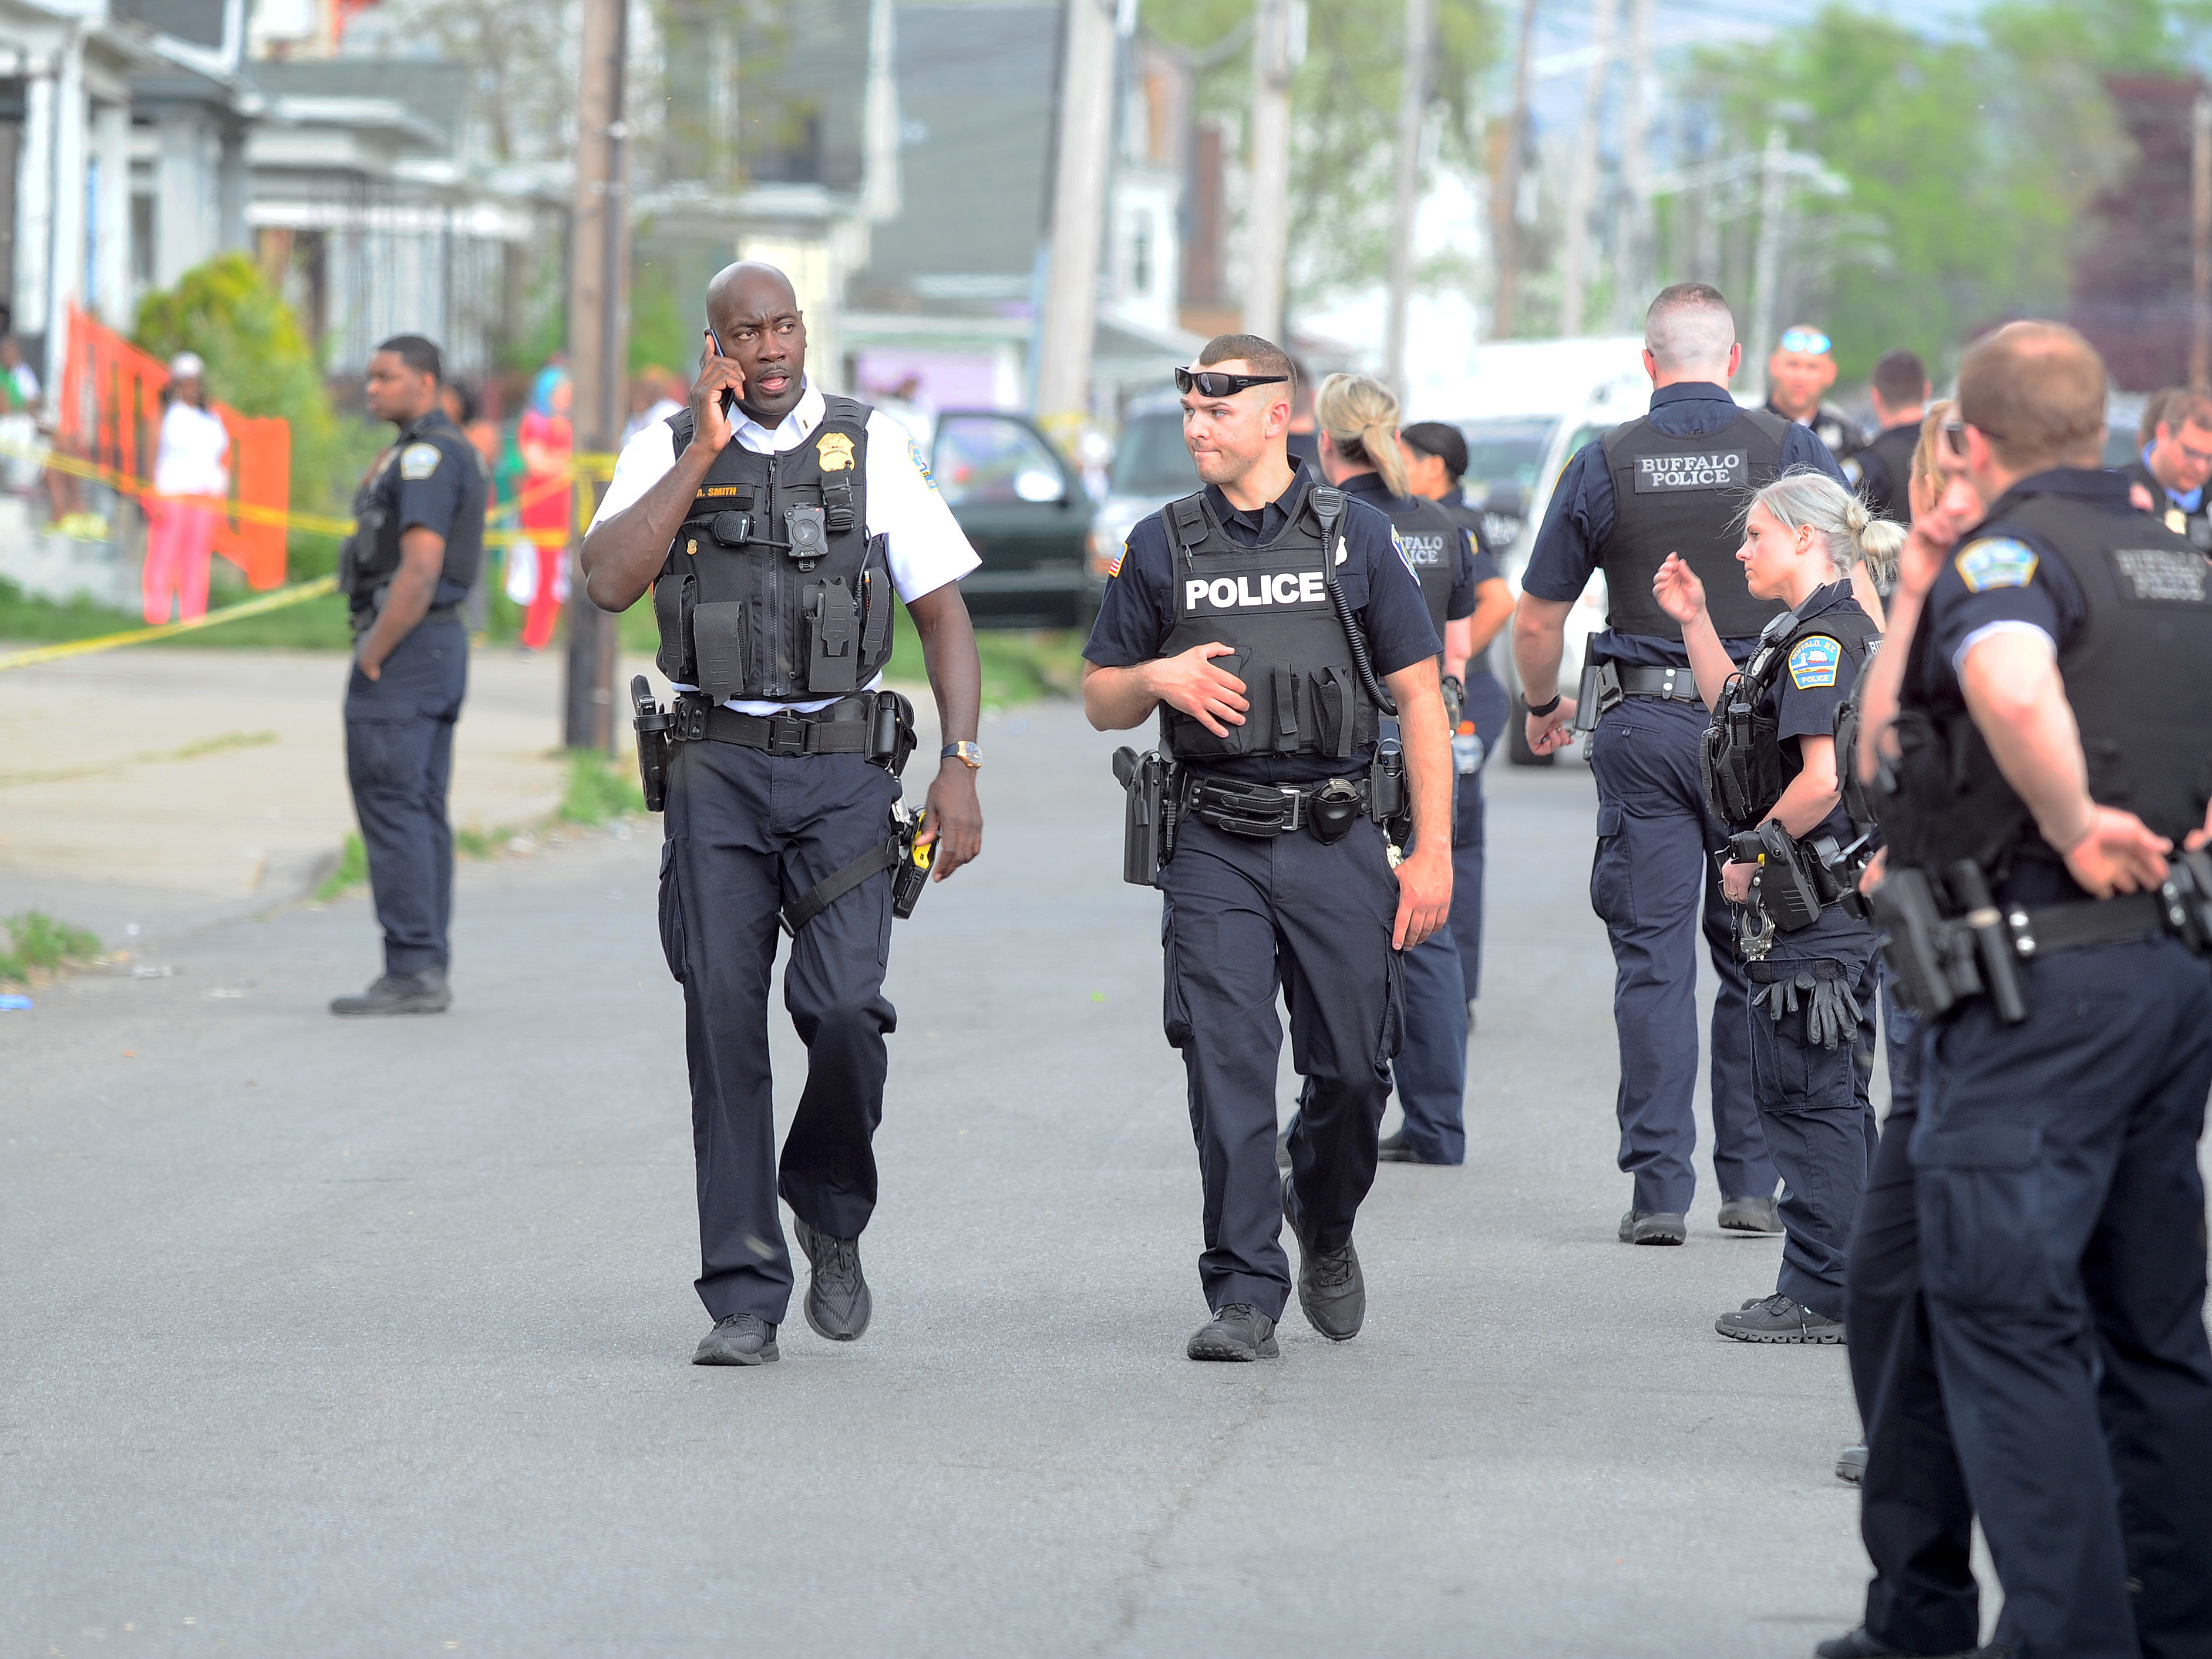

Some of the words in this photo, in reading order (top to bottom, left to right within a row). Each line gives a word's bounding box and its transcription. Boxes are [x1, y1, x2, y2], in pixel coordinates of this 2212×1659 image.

[1641, 454, 1739, 473] BUFFALO
[1652, 469, 1730, 486] POLICE
[696, 488, 705, 497] A.
[708, 487, 737, 496] SMITH
[1400, 536, 1443, 551] FALO
[1410, 550, 1439, 564] ICE
[1186, 571, 1326, 610] POLICE
[1802, 675, 1829, 684] POLICE
